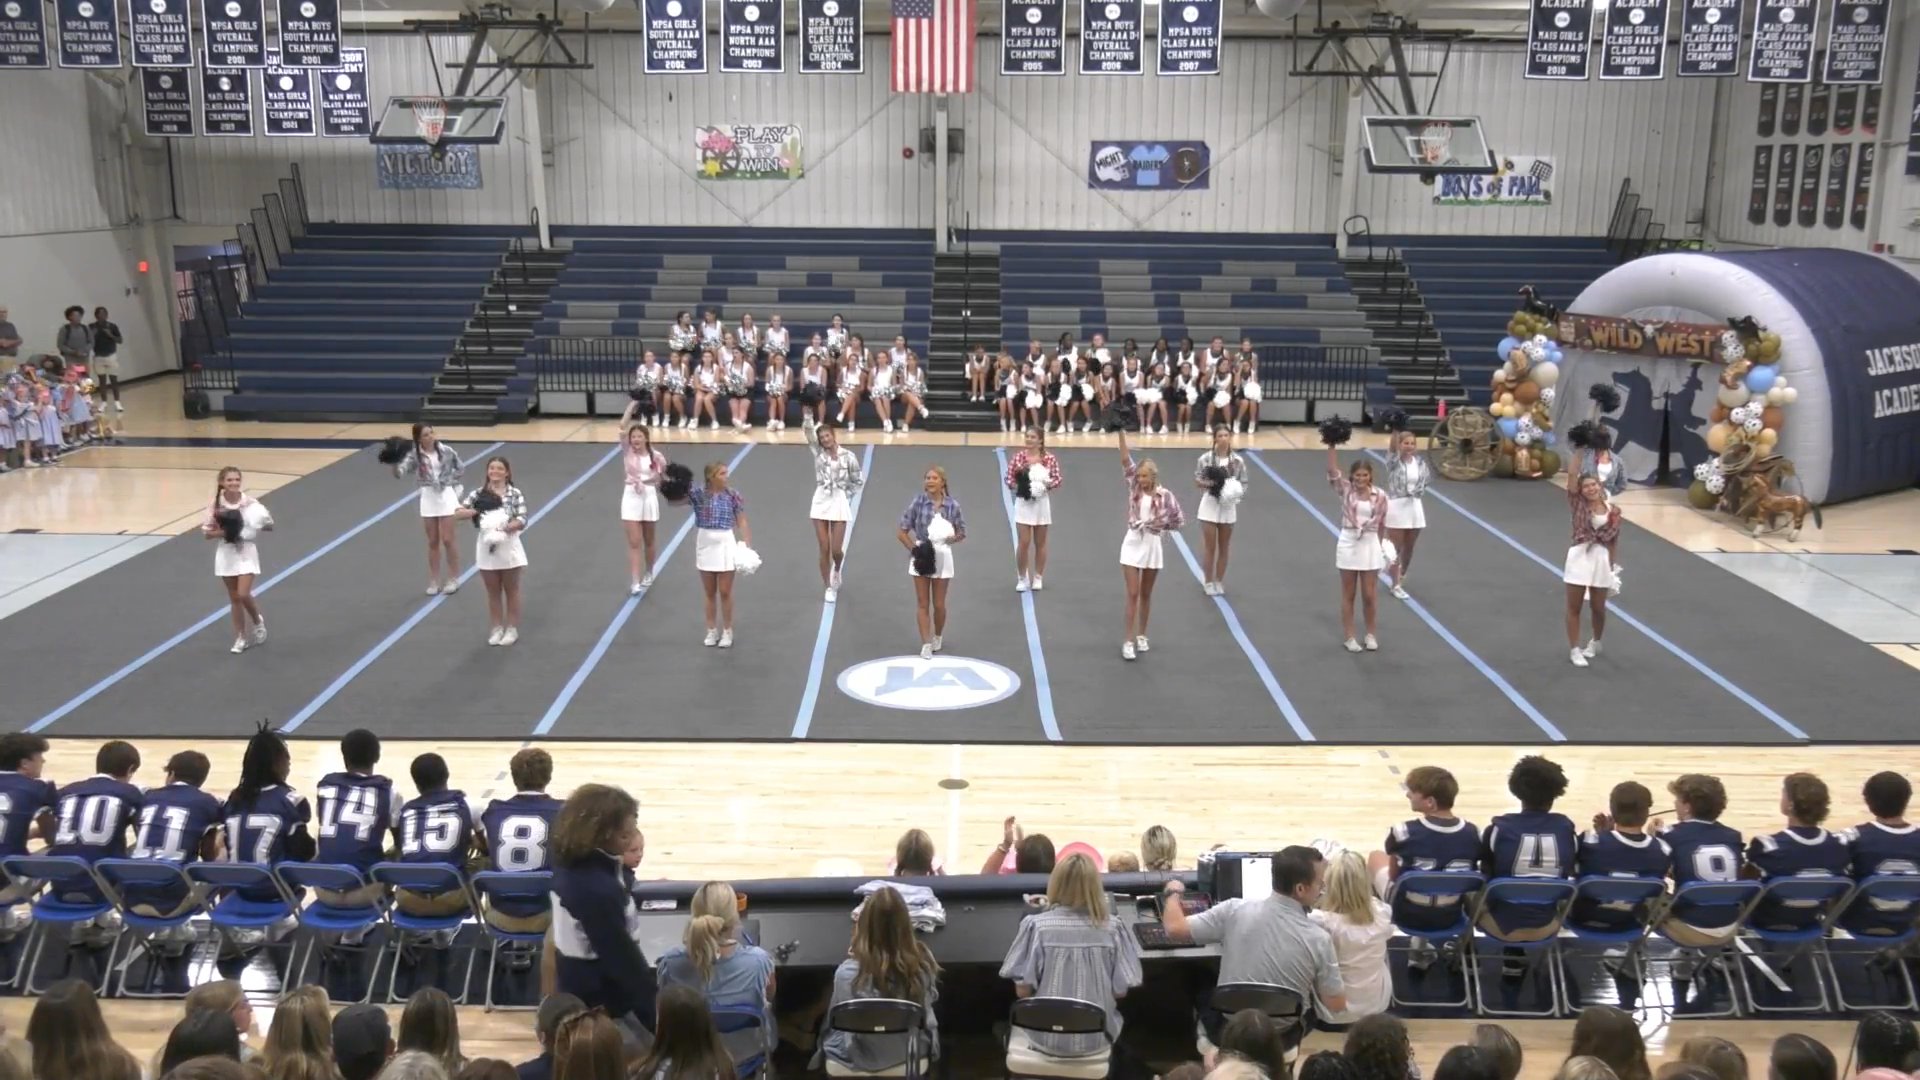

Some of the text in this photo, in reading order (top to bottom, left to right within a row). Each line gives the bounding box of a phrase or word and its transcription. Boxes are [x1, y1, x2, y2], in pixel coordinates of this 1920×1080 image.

[1540, 0, 1587, 8] ACADEMY
[1615, 0, 1661, 8] ACADEMY
[1692, 0, 1737, 8] ACADEMY
[1766, 0, 1810, 8] ACADEMY
[137, 14, 183, 23] MPSA GIRLS
[808, 17, 854, 26] MPSA BOYS
[66, 21, 109, 30] MPSA BOYS
[135, 24, 186, 33] SOUTH AAAA
[211, 21, 258, 31] MPSA GIRLS
[287, 21, 331, 30] MPSA BOYS
[652, 20, 697, 29] MPSA GIRLS
[730, 24, 775, 35] MPSA BOYS
[1091, 21, 1135, 30] MPSA BOYS
[1691, 24, 1734, 33] MAIS BOYS
[1763, 23, 1809, 32] MAIS GIRLS
[1836, 25, 1880, 34] MAIS GIRLS
[649, 29, 700, 39] SOUTH AAAA
[808, 26, 854, 35] NORTH AAA
[1011, 27, 1057, 37] MPSA BOYS
[1168, 27, 1213, 37] MPSA BOYS
[1613, 25, 1659, 35] MAIS GIRLS
[63, 32, 114, 41] SOUTH AAAA
[135, 34, 186, 43] CLASS AAAA
[216, 32, 253, 42] OVERALL
[283, 32, 337, 42] SOUTH AAAA
[808, 35, 854, 44] CLASS AAA
[1084, 31, 1128, 40] CLASS AAA
[1538, 31, 1584, 41] MAIS GIRLS
[1607, 36, 1652, 45] CLASS AAA
[1684, 33, 1727, 43] CLASS AAA
[1756, 31, 1802, 41] CLASS AAAA
[656, 39, 693, 49] OVERALL
[729, 36, 775, 46] NORTH AAA
[1006, 38, 1050, 48] CLASS AAA
[1092, 41, 1131, 50] OVERALL
[1161, 38, 1206, 48] CLASS AAA
[1757, 40, 1808, 50] CLASS AAAA
[0, 44, 39, 53] HAMPIONS
[66, 43, 112, 53] CHAMPIONS
[140, 44, 185, 53] CHAMPIONS
[212, 44, 259, 53] CHAMPIONS
[288, 44, 334, 54] CHAMPIONS
[812, 44, 851, 53] OVERALL
[1532, 41, 1576, 52] CLASS AAA
[1610, 46, 1656, 55] CLASS AAA
[1687, 43, 1733, 52] CLASS AAA
[1832, 43, 1880, 52] CLASS AAAA
[653, 50, 698, 60] CHAMPIONS
[729, 47, 775, 58] CHAMPIONS
[809, 53, 854, 61] CHAMPIONS
[1010, 50, 1056, 60] CHAMPIONS
[1089, 51, 1135, 61] CHAMPIONS
[1166, 50, 1213, 60] CHAMPIONS
[1686, 52, 1733, 61] CHAMPIONS
[1763, 50, 1800, 59] OVERALL
[1836, 52, 1874, 61] OVERALL
[227, 55, 246, 64] 2001
[302, 55, 321, 65] 2001
[742, 59, 762, 68] 2003
[1535, 53, 1581, 64] CHAMPIONS
[1610, 56, 1656, 65] CHAMPIONS
[665, 60, 686, 69] 2002
[821, 61, 842, 70] 2004
[1022, 61, 1043, 71] 2005
[1101, 61, 1122, 71] 2006
[1179, 61, 1199, 71] 2007
[1699, 61, 1717, 71] 2014
[1758, 59, 1804, 69] CHAMPIONS
[1832, 61, 1876, 70] CHAMPIONS
[1547, 65, 1567, 75] 2010
[1623, 66, 1641, 75] 2011
[286, 91, 307, 100] GIRLS
[265, 101, 287, 109] CLASS
[269, 111, 309, 119] CHAMPIONS
[734, 127, 786, 144] PLAY
[754, 145, 775, 157] TO
[383, 151, 468, 175] VICTORY
[742, 157, 779, 172] WIN
[1441, 174, 1483, 198] BOYS
[1508, 176, 1541, 196] FALL
[1589, 326, 1643, 350] WILD
[1655, 332, 1715, 357] WEST
[1865, 343, 1920, 376] JACKSO
[1874, 384, 1920, 418] ACADE
[318, 784, 379, 842] 14
[56, 794, 122, 846] 10
[131, 804, 189, 862] 11
[402, 801, 463, 855] 15
[225, 814, 283, 865] 17
[497, 815, 549, 872] 8
[1511, 833, 1562, 878] 4
